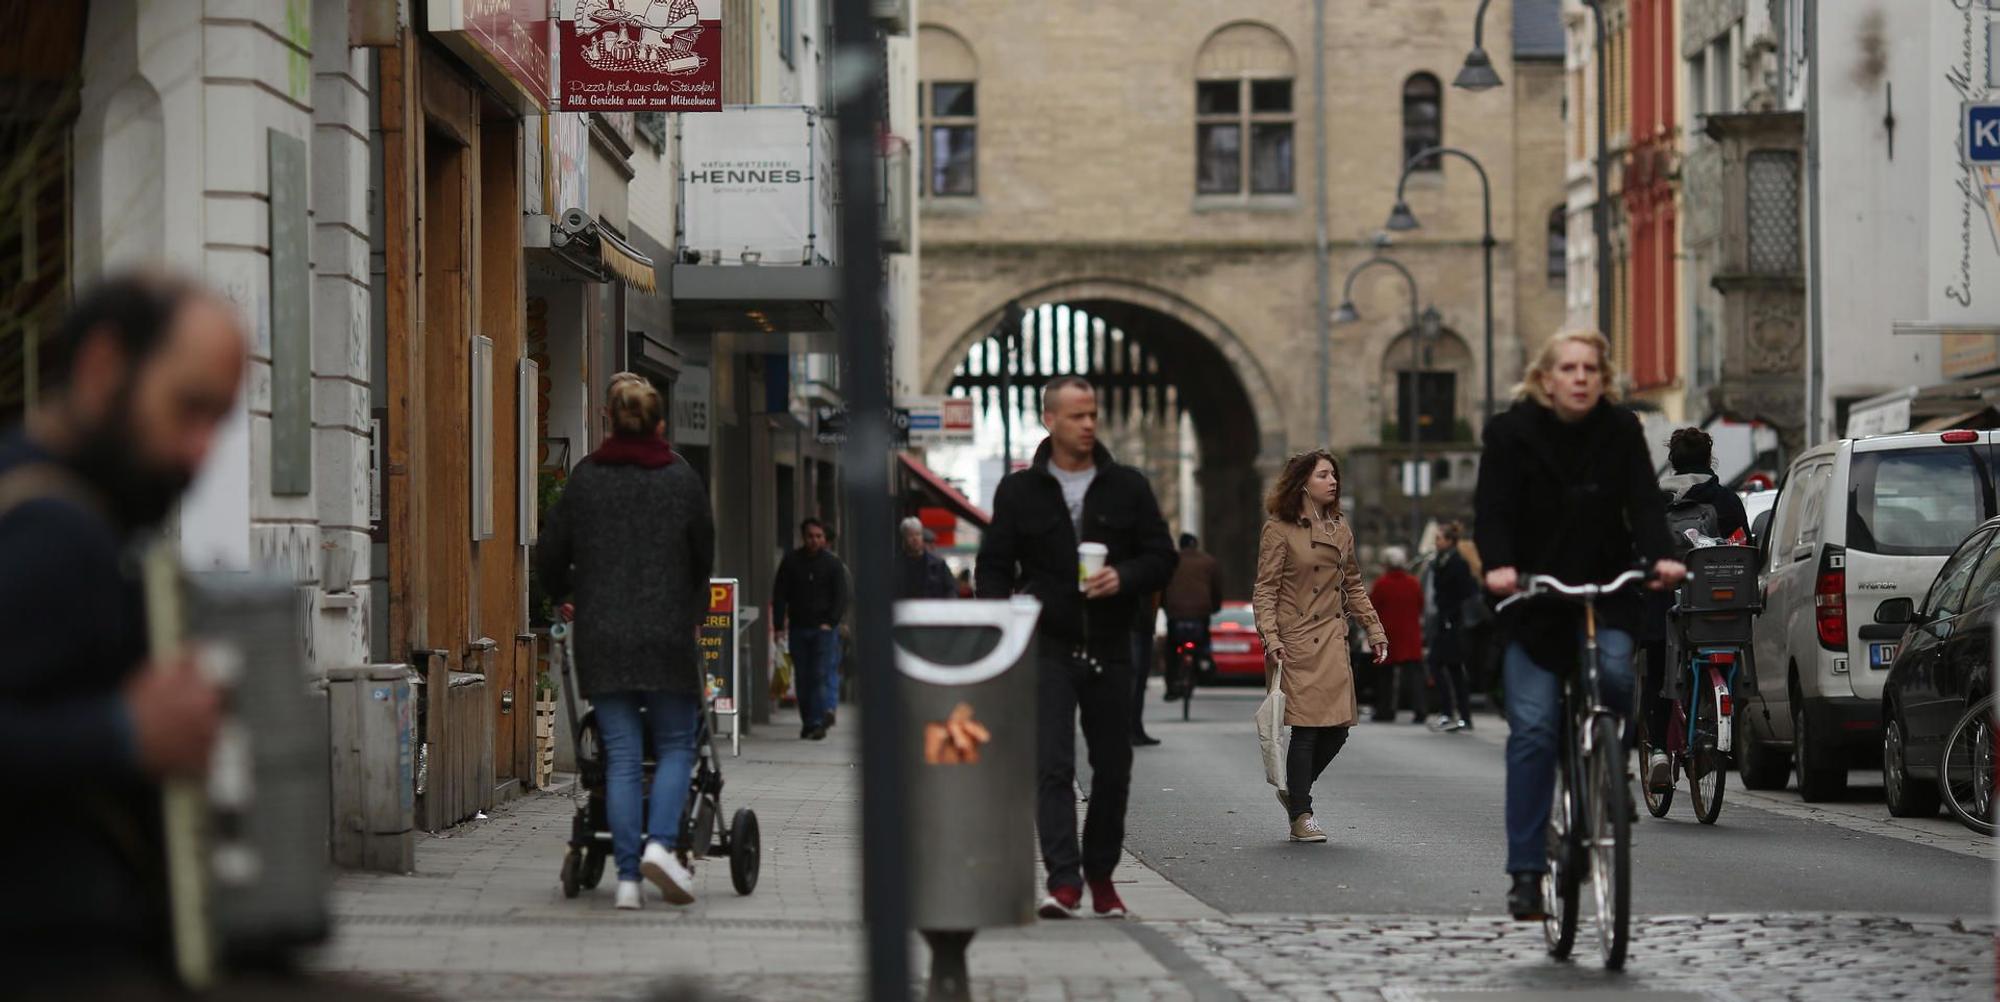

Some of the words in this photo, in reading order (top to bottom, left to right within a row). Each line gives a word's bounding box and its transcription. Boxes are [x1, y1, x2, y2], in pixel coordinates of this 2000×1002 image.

[568, 80, 605, 92] Pizza
[606, 80, 633, 95] frisch
[634, 83, 651, 92] aus
[568, 95, 587, 105] Alle
[590, 95, 624, 105] Gerichte
[627, 95, 647, 105] auch
[650, 97, 667, 105] zum
[670, 95, 716, 106] Mitnehmen
[1977, 118, 2000, 148] K
[690, 169, 802, 185] HENNES
[710, 586, 727, 608] P
